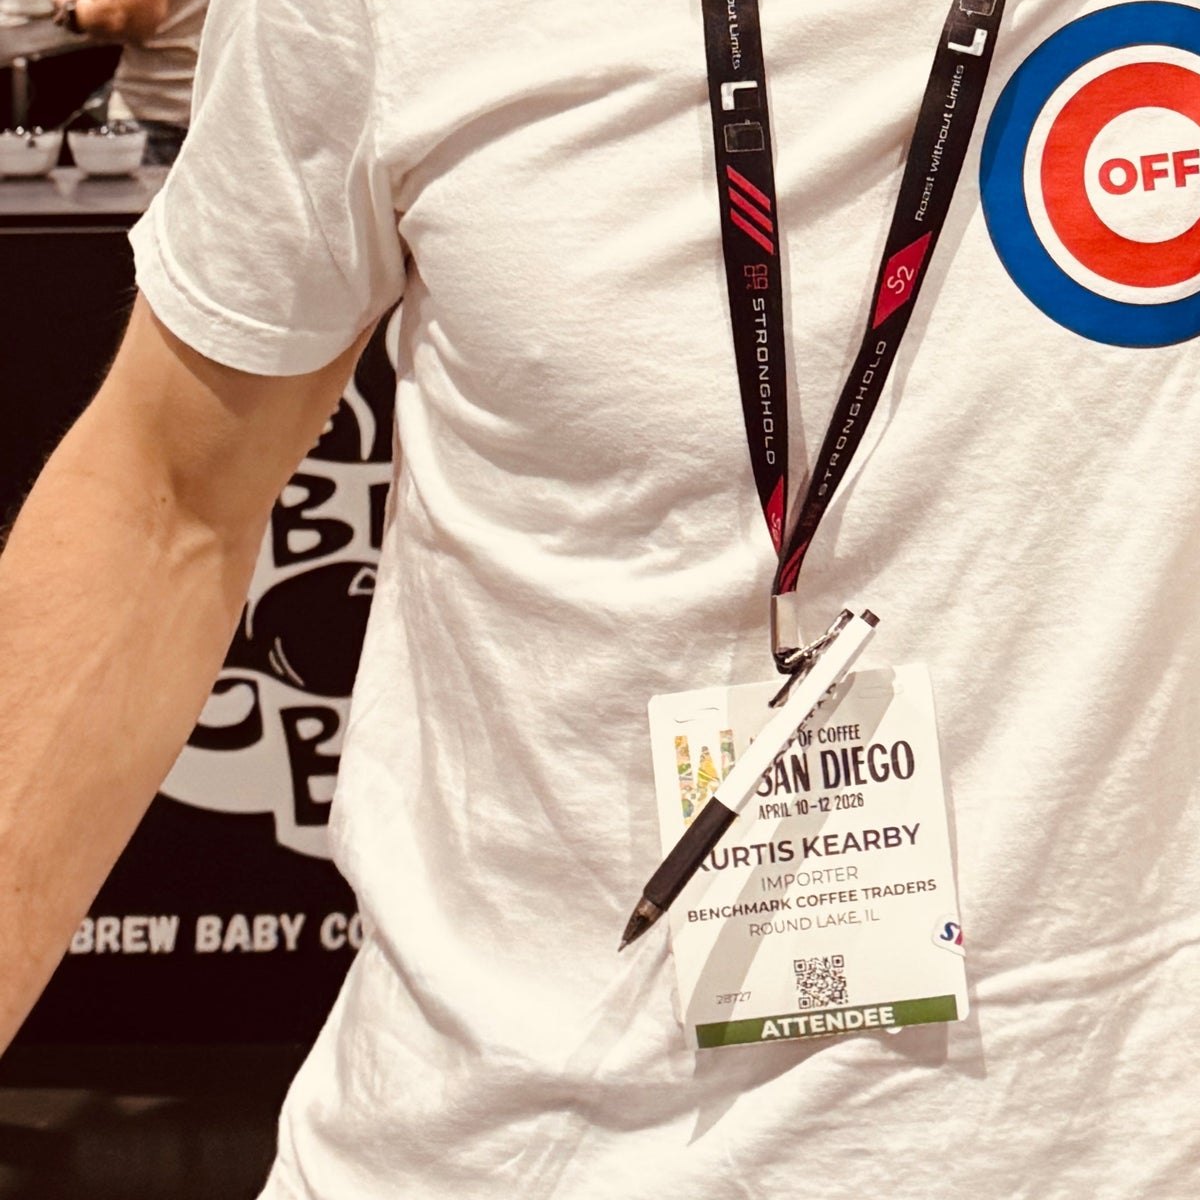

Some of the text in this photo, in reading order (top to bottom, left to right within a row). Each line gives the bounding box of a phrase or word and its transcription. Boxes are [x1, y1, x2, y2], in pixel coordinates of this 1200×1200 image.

[930, 113, 953, 172] without
[945, 64, 965, 109] Limits
[886, 265, 915, 295] S2
[751, 297, 776, 465] STRONGHOLD
[818, 340, 887, 496] STRONGHOLD
[818, 724, 861, 744] COFFEE
[820, 740, 915, 790] DIEGO
[758, 802, 792, 820] APRIL
[835, 792, 865, 810] 2026
[803, 823, 921, 859] KEARBY
[761, 865, 859, 892] IMPORTER
[687, 879, 937, 923] BENCHMARK COFFEE TRADERS
[70, 915, 180, 954] BREW
[195, 913, 306, 953] BABY
[750, 916, 812, 937] ROUND
[866, 908, 881, 922] IL
[761, 1006, 895, 1039] ATTENDEE
